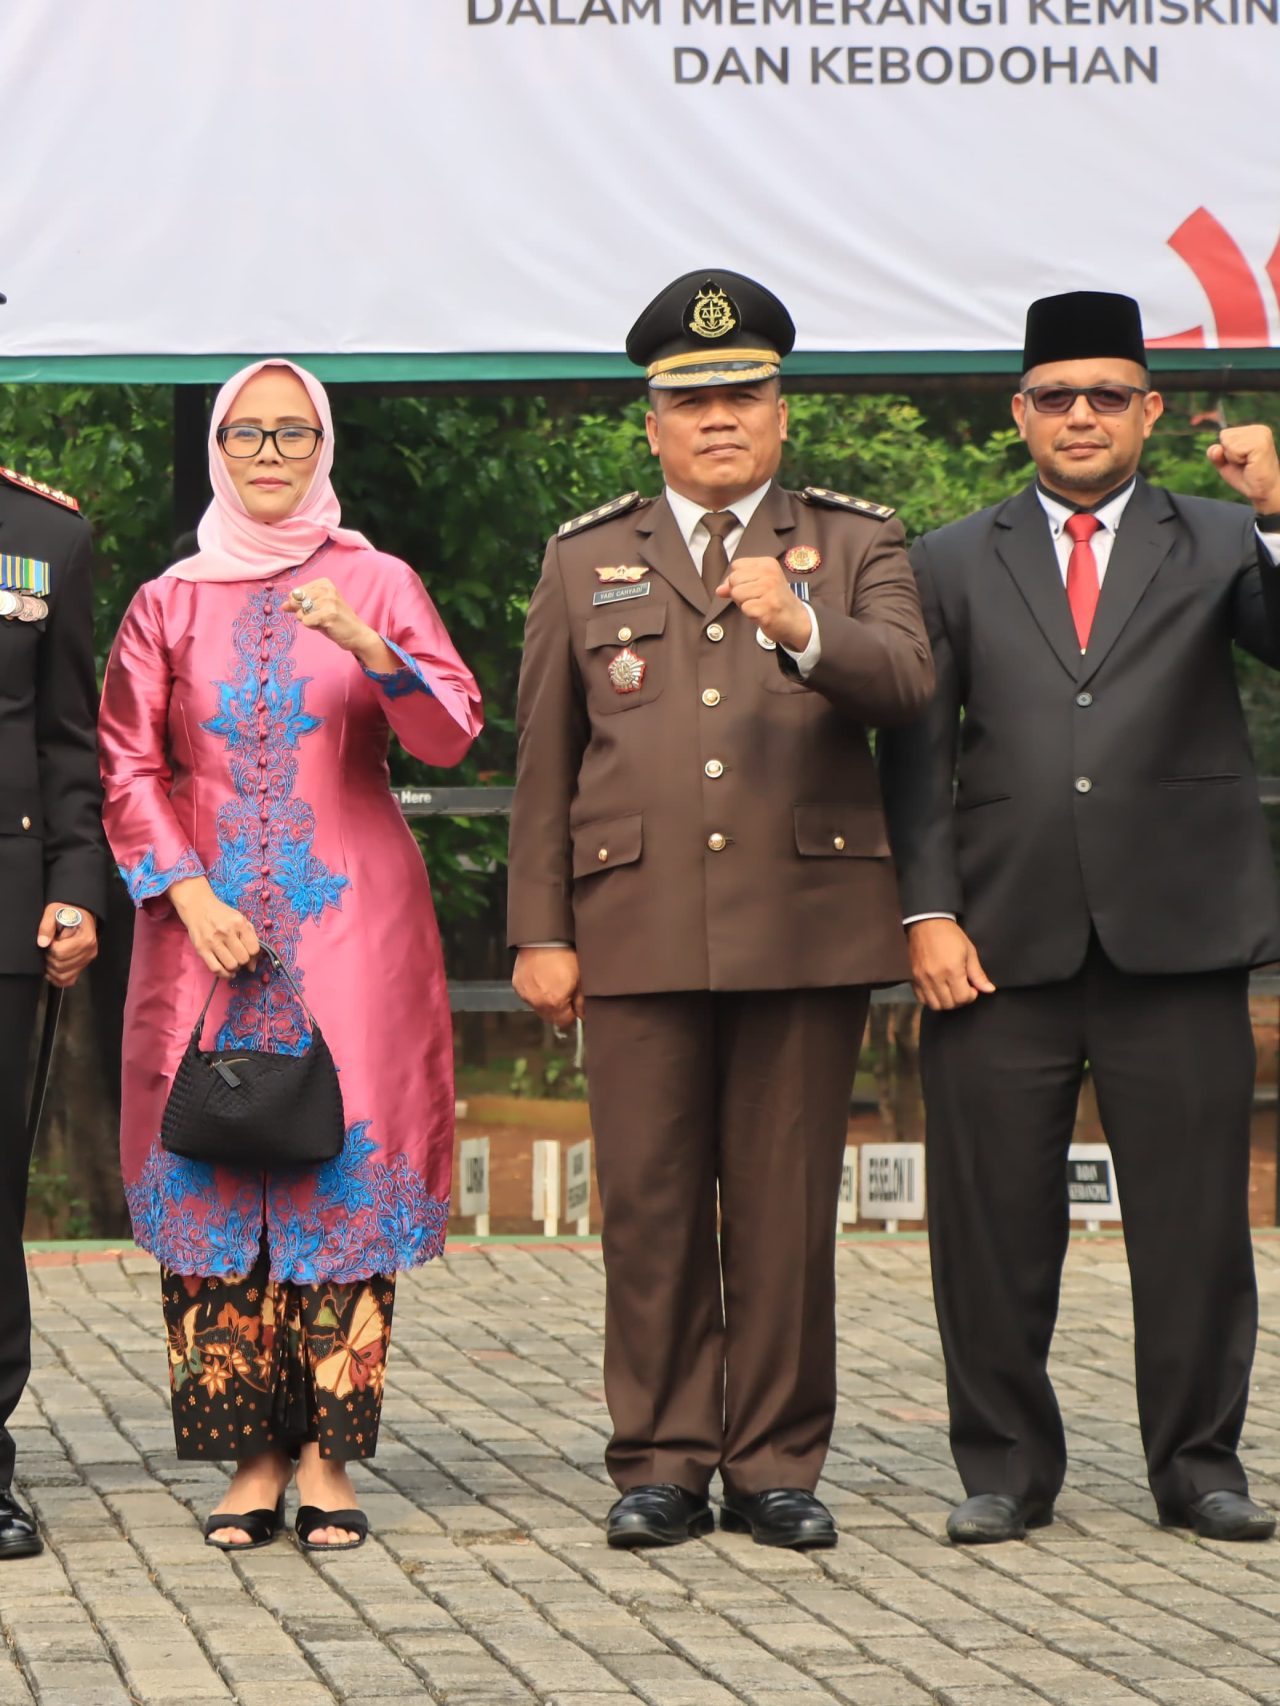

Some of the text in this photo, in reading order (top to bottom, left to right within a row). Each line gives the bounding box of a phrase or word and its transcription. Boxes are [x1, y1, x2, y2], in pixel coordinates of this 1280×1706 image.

[467, 0, 1279, 26] DALAM MEMERANGI KEMISKIN
[673, 45, 1158, 85] DAN KEBODOHAN
[401, 790, 432, 804] Here
